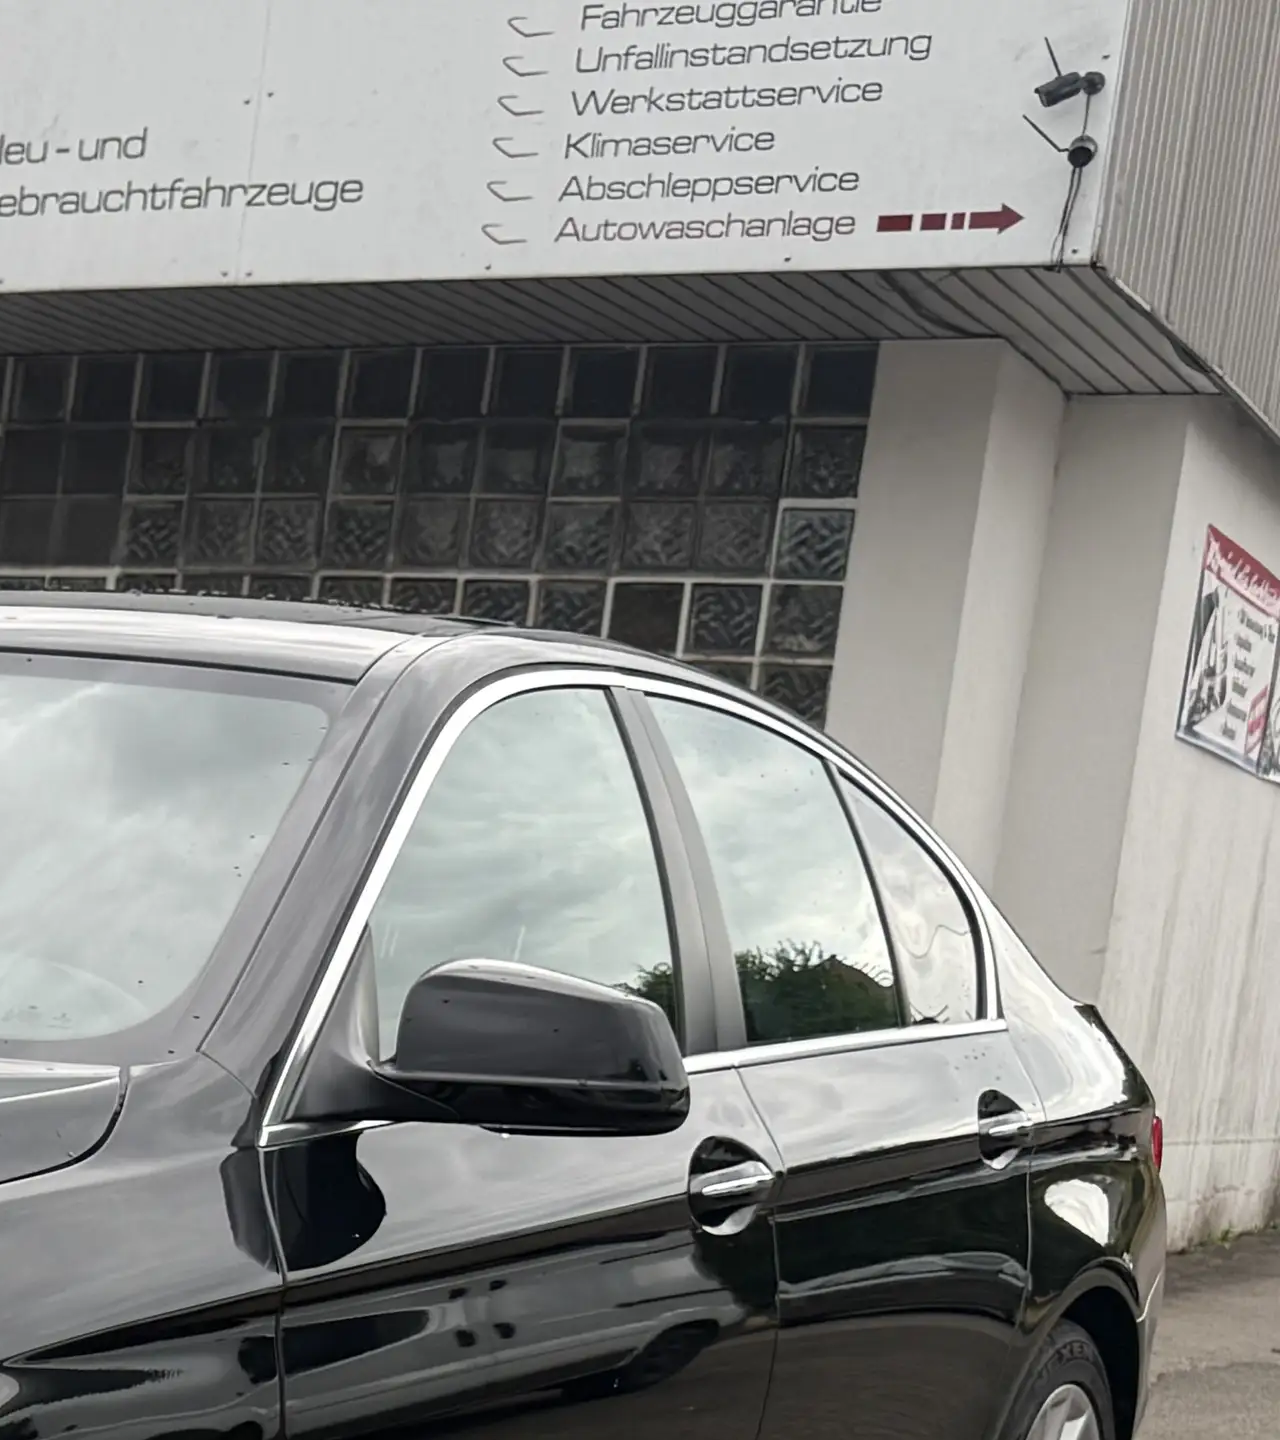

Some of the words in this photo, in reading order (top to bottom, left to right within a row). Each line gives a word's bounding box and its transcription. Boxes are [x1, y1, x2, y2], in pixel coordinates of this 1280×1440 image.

[580, 0, 882, 31] Fahrzeuggarantie
[576, 35, 933, 73] Unfallinstandsetzung
[571, 77, 883, 116] Werkstattservice
[564, 126, 776, 159] Klimaservice
[558, 166, 860, 202] Abschleppservice
[553, 210, 857, 243] Autowaschanlage
